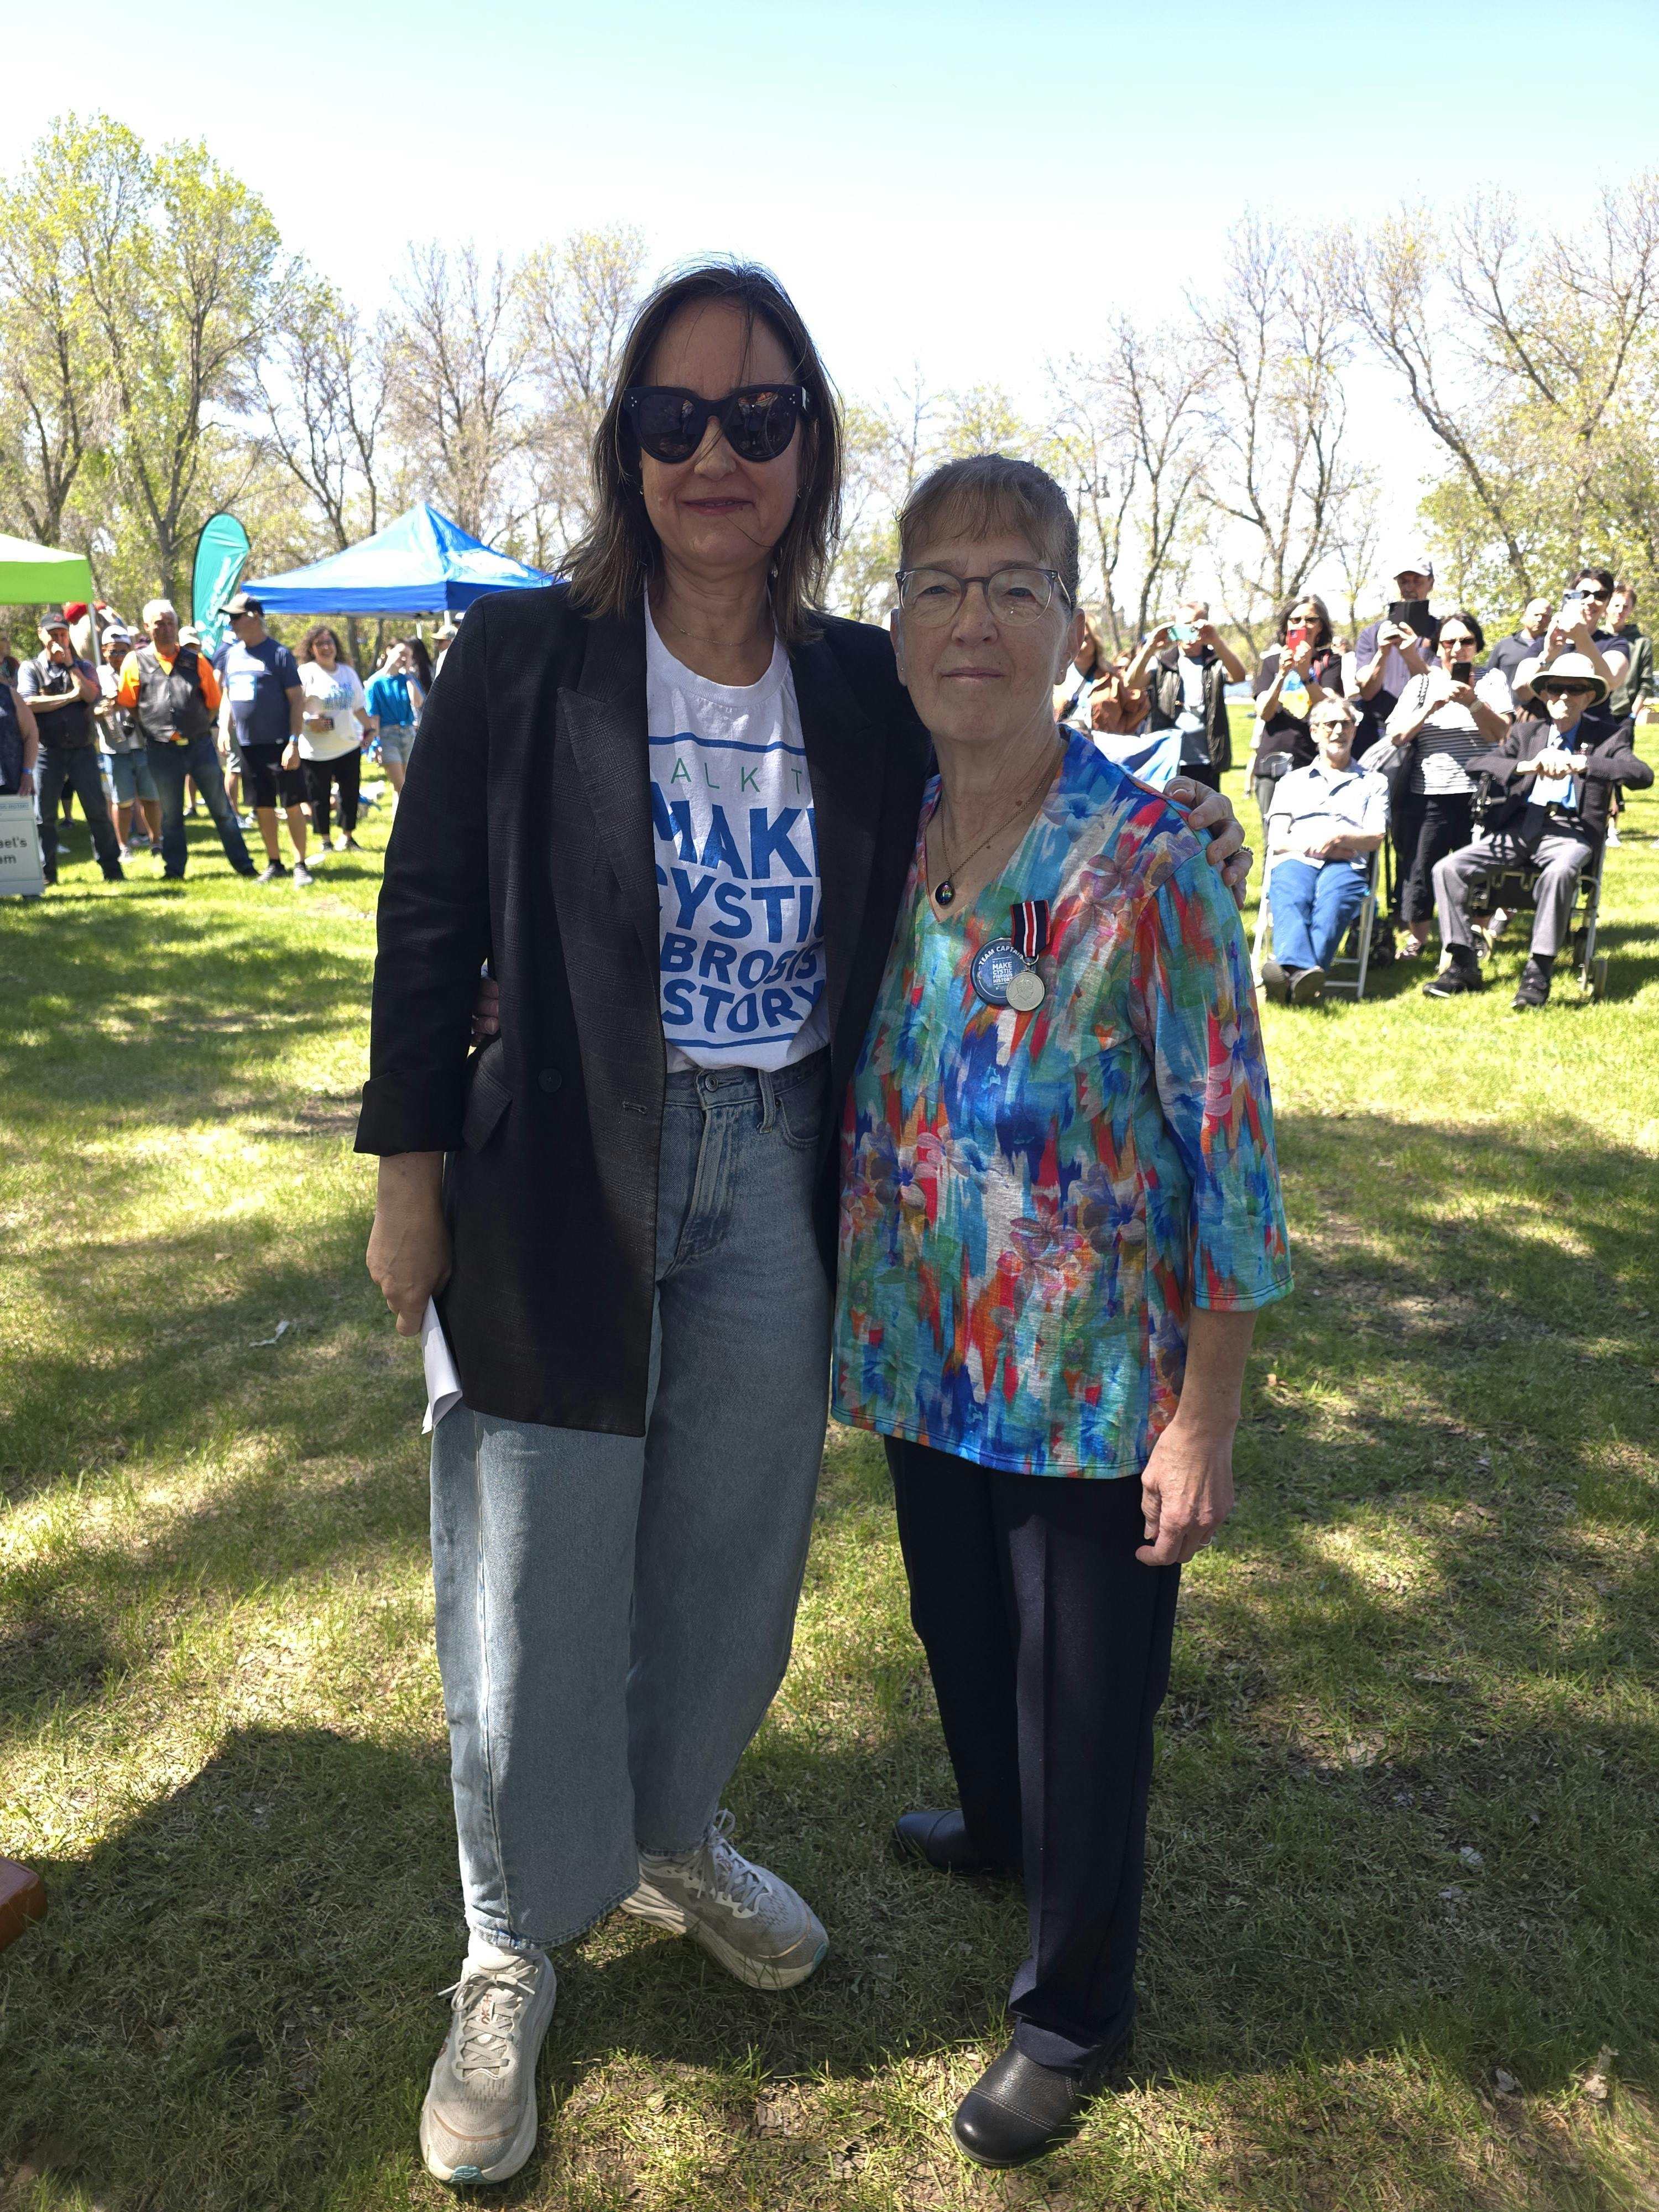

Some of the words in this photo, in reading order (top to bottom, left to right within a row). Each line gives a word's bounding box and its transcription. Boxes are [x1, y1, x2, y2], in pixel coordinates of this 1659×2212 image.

[650, 781, 820, 880] MAK
[978, 948, 995, 965] TEAM
[992, 962, 1013, 970] MAKE
[661, 978, 826, 1034] STORY
